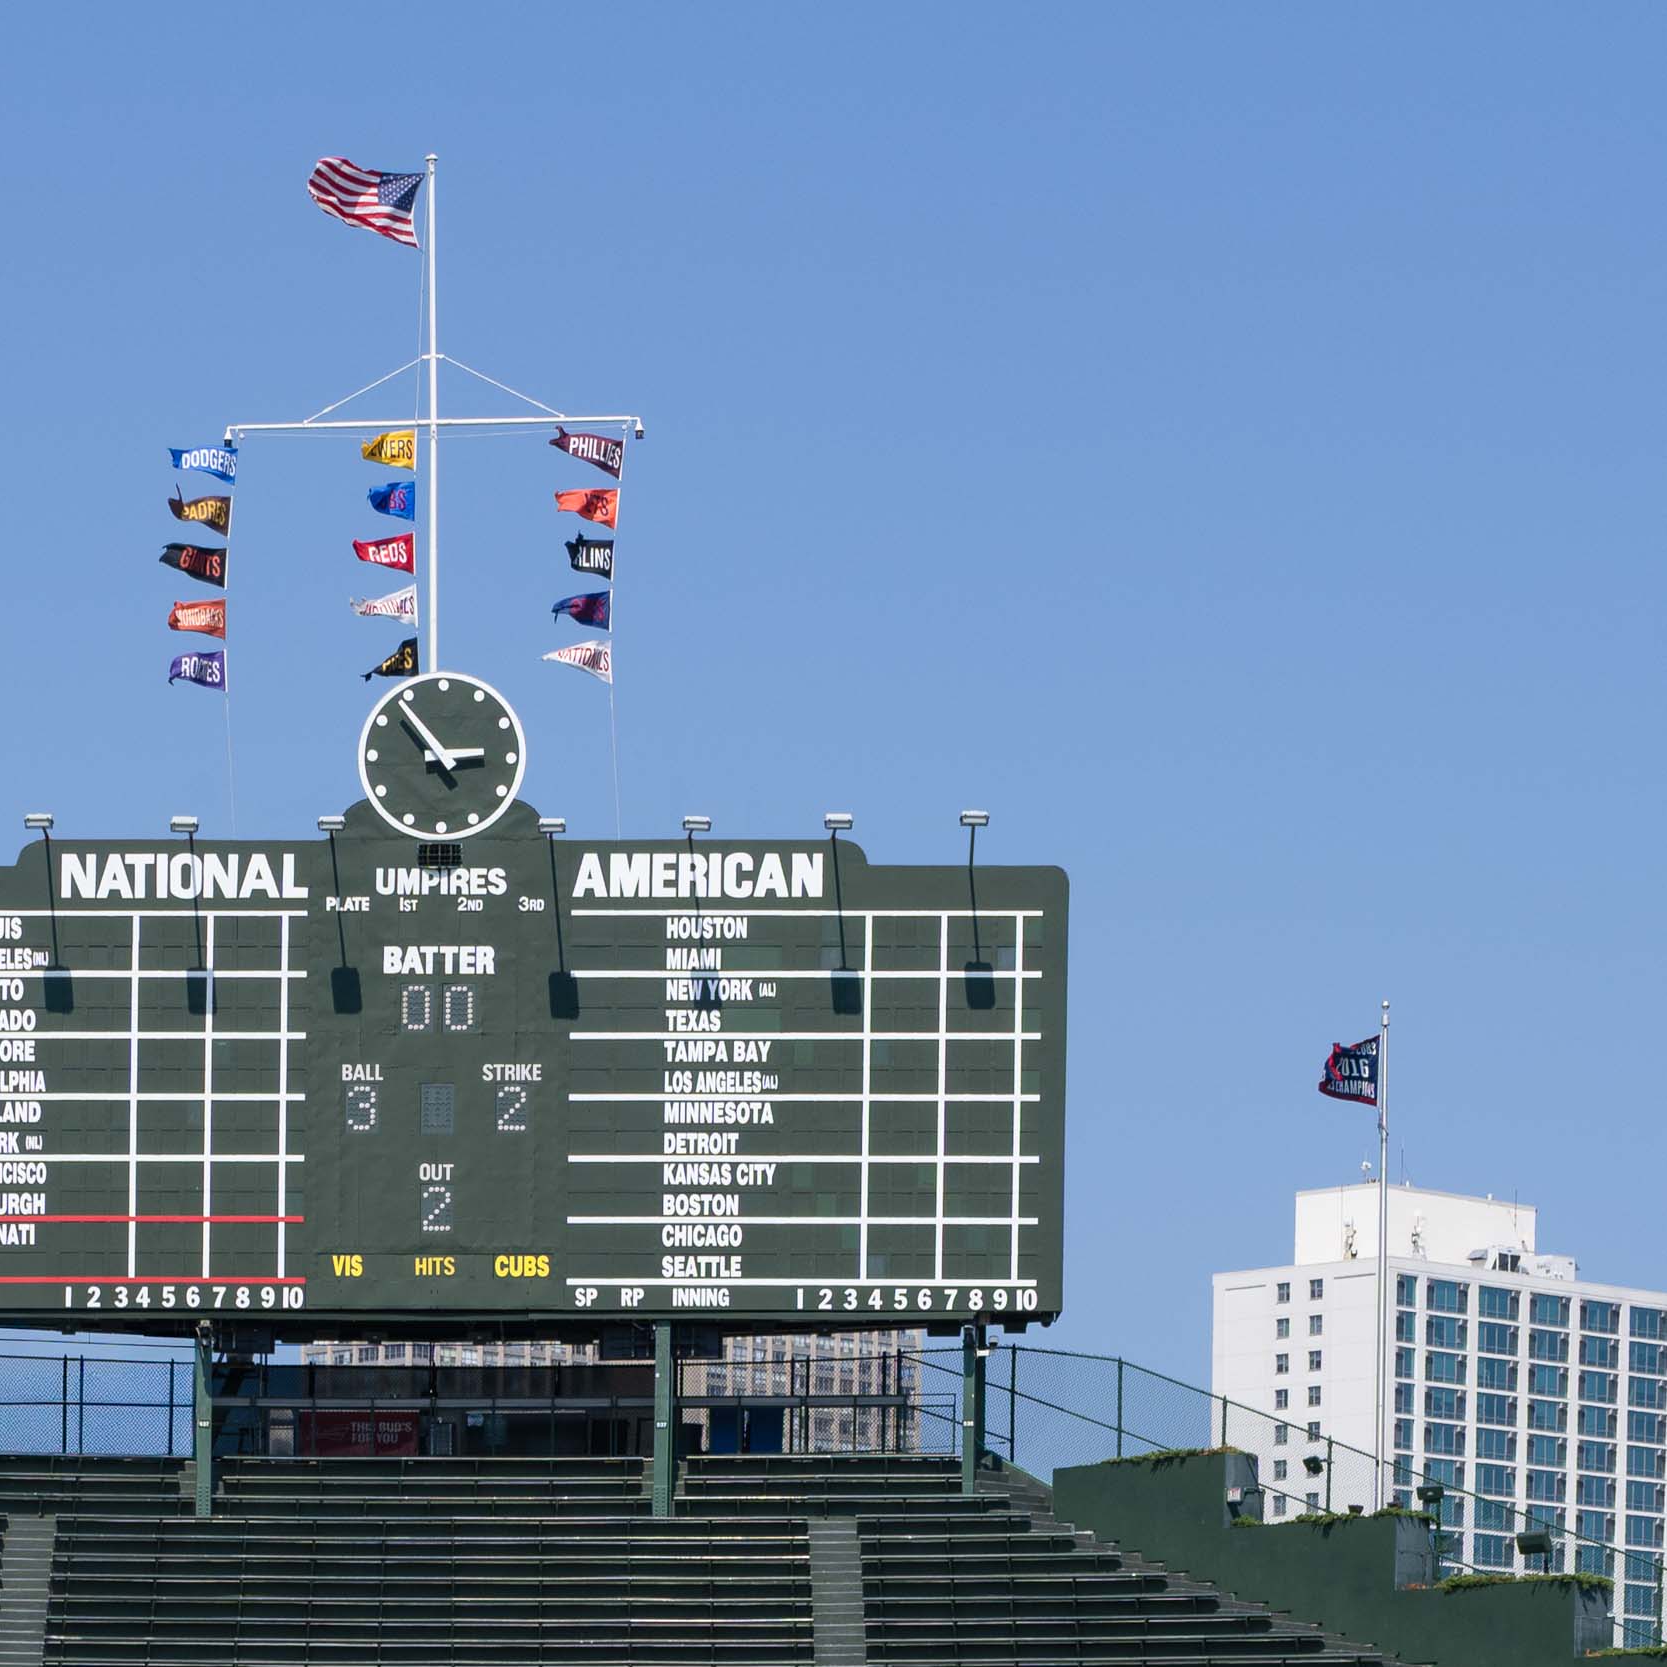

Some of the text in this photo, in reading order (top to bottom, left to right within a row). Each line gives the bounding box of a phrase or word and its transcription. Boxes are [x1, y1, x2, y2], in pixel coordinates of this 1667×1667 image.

[182, 449, 236, 476] DODGERS
[569, 437, 621, 468] PHILLIES
[368, 542, 407, 563] REDS
[60, 852, 309, 900] NATIONAL
[375, 867, 508, 896] UMPIRES
[571, 851, 824, 899] AMERICAN
[325, 896, 370, 911] PLATE
[457, 897, 483, 911] 2ND
[518, 896, 545, 911] 3RD
[666, 916, 748, 940] HOUSTON
[383, 945, 495, 975] BATTER
[665, 947, 722, 971] MIAMI
[665, 978, 776, 1002] NEW YORK (AL)
[665, 1009, 722, 1033] TEXAS
[663, 1040, 772, 1063] TAMPA BAY
[342, 1064, 384, 1081] BALL
[482, 1063, 542, 1081] STRIKE
[663, 1070, 693, 1095] LOS
[348, 1085, 376, 1131] 3
[497, 1085, 526, 1131] 2
[663, 1101, 774, 1125] MINNESOTA
[26, 1136, 42, 1150] (NL)
[663, 1132, 740, 1155] DETROIT
[419, 1163, 454, 1181] OUT
[663, 1163, 777, 1186] KANSAS CITY
[422, 1186, 451, 1232] 2
[662, 1193, 740, 1217] BOSTON
[661, 1224, 743, 1248] CHICAGO
[332, 1255, 363, 1277] VIS
[414, 1257, 455, 1276] HITS
[494, 1255, 550, 1277] CUBS
[660, 1255, 744, 1280] SEATTLE
[65, 1286, 72, 1308] 1
[86, 1285, 101, 1308] 2
[114, 1286, 129, 1308] 3
[135, 1286, 151, 1308] 4
[161, 1285, 176, 1308] 5
[185, 1285, 201, 1308] 6
[212, 1286, 227, 1308] 7
[235, 1286, 251, 1309] 8
[260, 1286, 276, 1309] 9
[282, 1286, 304, 1309] 10
[574, 1287, 1038, 1311] SP RP INNING 1 2 3 4 5 6 7 8 9 10
